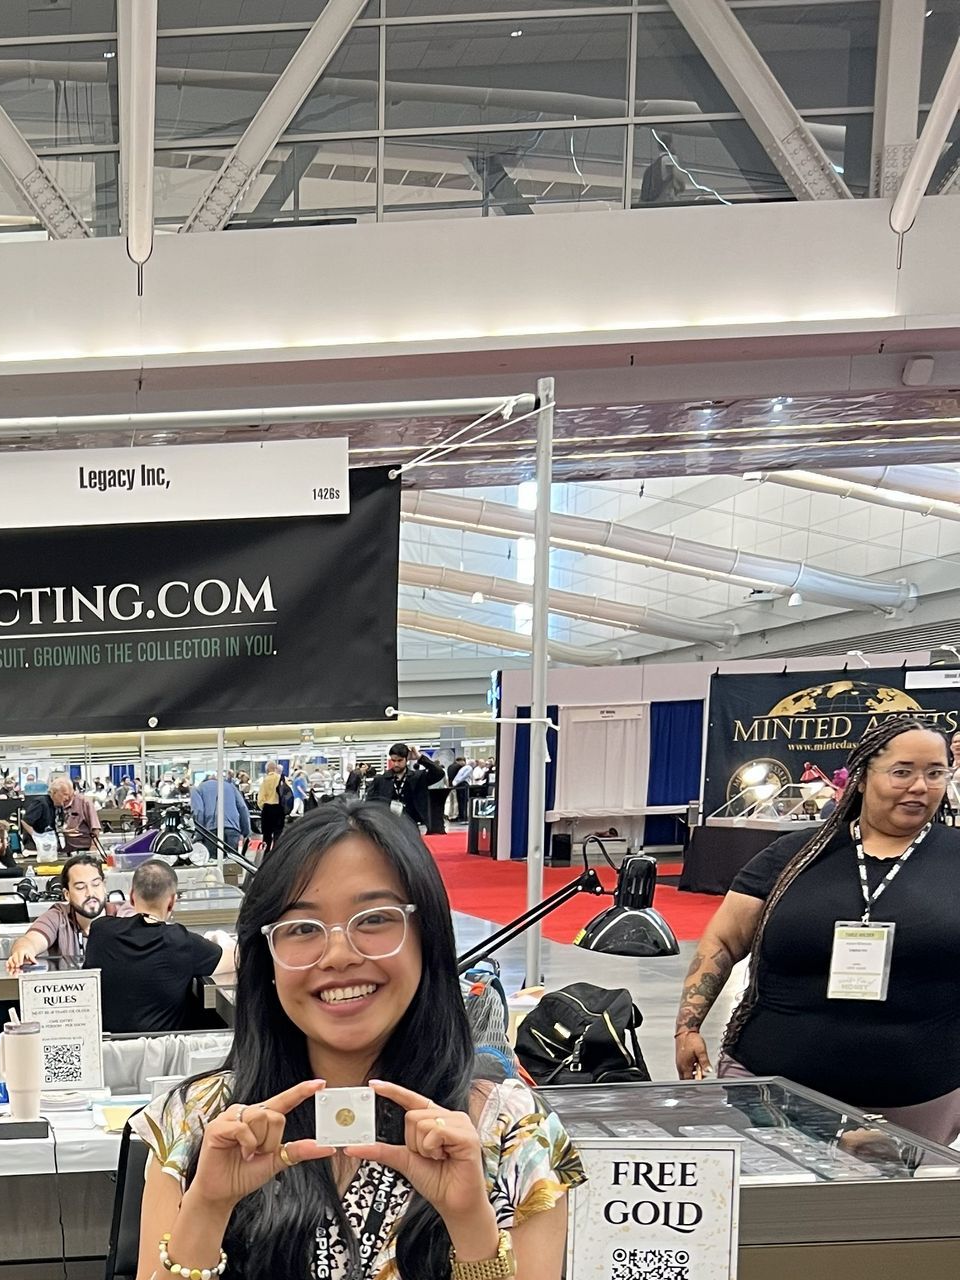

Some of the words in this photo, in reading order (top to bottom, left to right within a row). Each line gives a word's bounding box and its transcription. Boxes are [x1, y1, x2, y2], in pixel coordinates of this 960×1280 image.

[79, 466, 135, 491] Legacy
[141, 464, 170, 489] Inc,
[312, 486, 340, 501] 1426s
[34, 643, 100, 668] GROWING
[105, 641, 132, 664] THE
[138, 638, 220, 662] COLLECTOR
[226, 636, 239, 657] IN
[245, 634, 277, 656] YOU.
[733, 716, 852, 741] MINTED
[33, 983, 86, 994] GIVEAWAY
[43, 995, 77, 1006] RULES
[611, 1161, 698, 1192] FREE
[604, 1199, 703, 1234] GOLD
[316, 1237, 330, 1279] PMG
